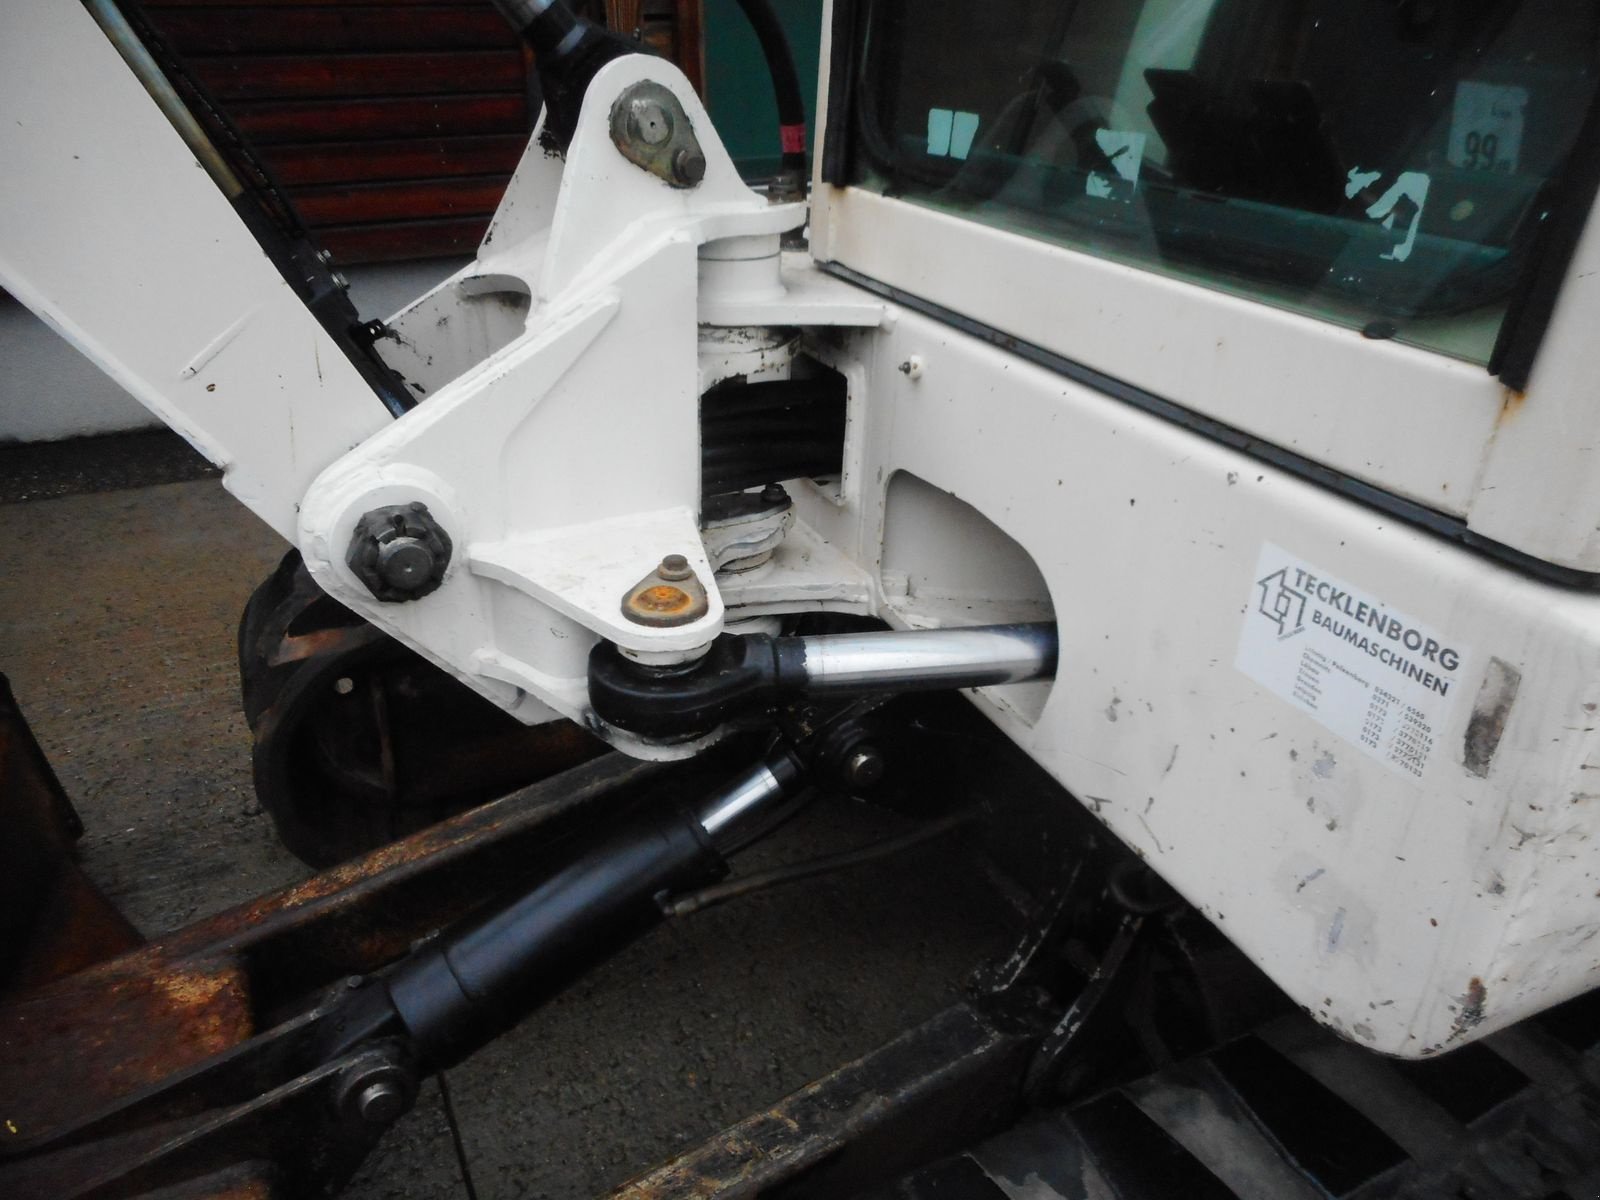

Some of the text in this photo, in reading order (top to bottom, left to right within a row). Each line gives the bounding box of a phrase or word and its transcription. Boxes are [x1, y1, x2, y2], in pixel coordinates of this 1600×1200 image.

[1464, 130, 1497, 169] 99
[1295, 568, 1460, 672] TECKLENBORG
[1312, 609, 1449, 697] BAUMASCHINEN
